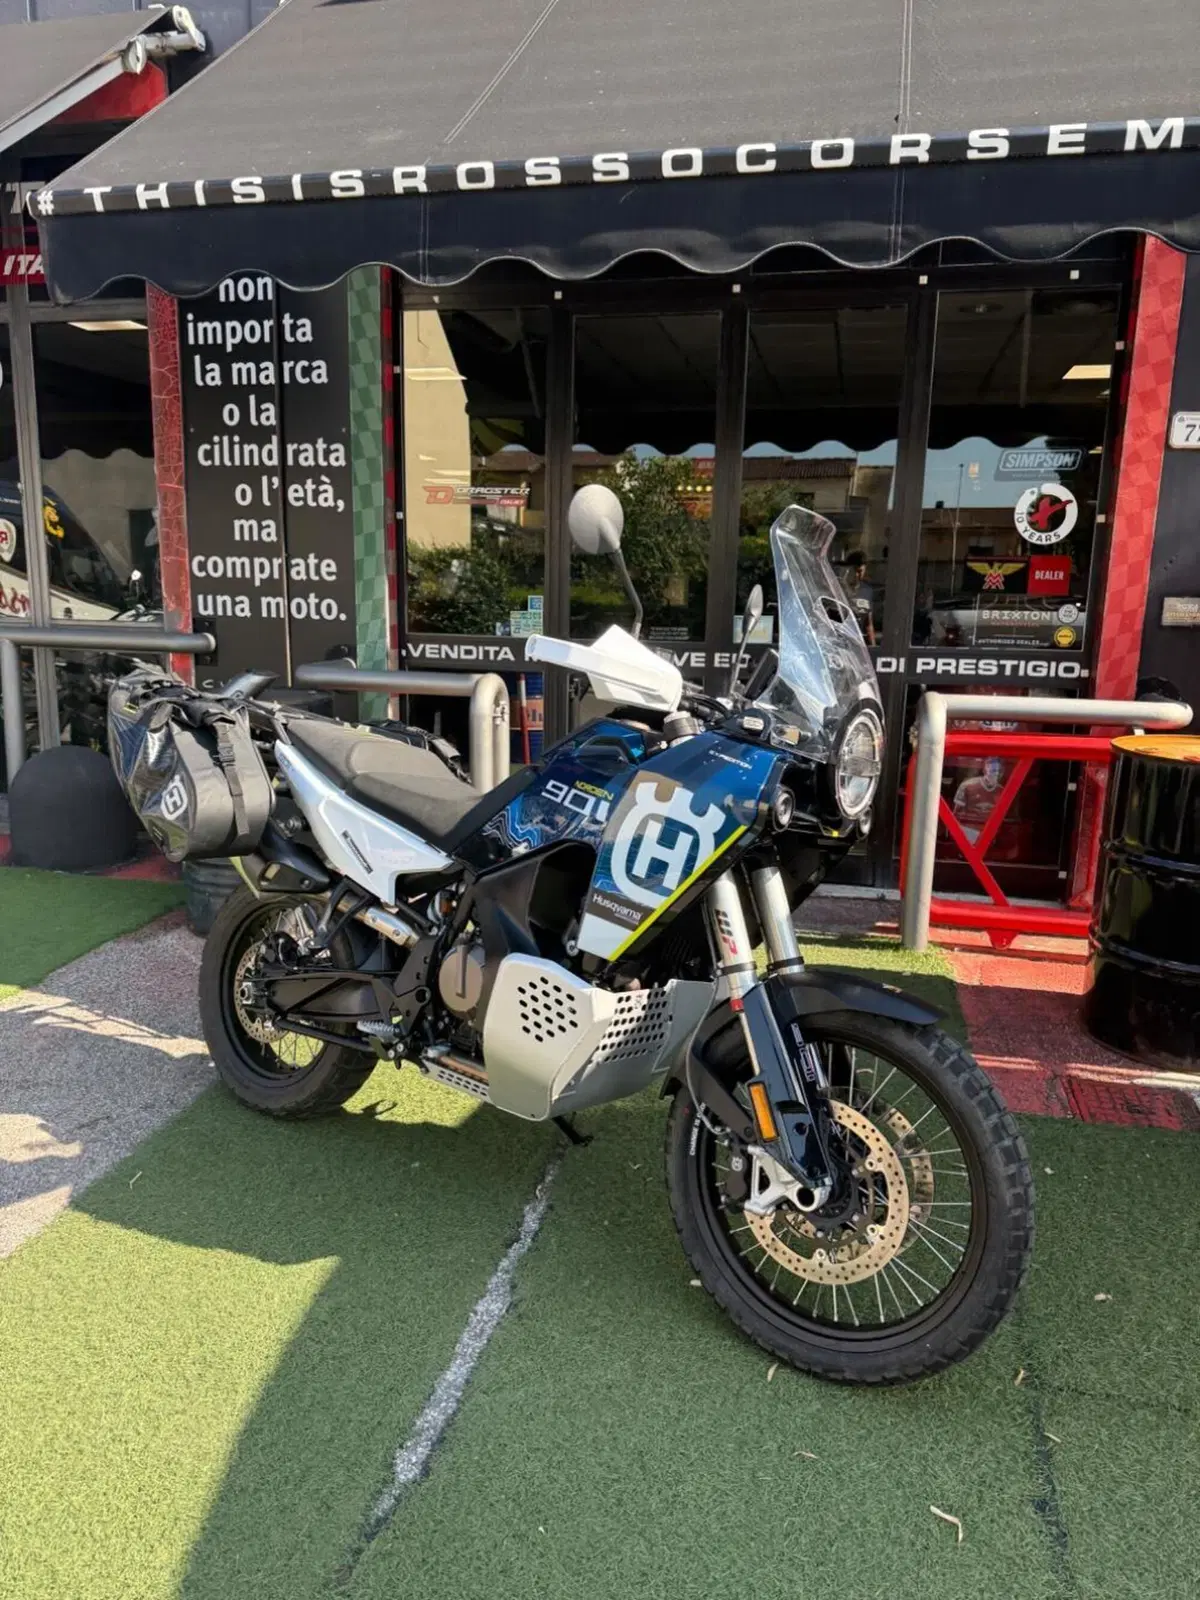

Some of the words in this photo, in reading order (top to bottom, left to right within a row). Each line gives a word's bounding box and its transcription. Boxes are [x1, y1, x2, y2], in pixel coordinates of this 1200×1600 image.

[219, 276, 275, 302] non
[187, 313, 314, 352] importa
[194, 355, 222, 387] la
[231, 358, 329, 386] marca
[222, 403, 240, 427] o
[249, 394, 277, 427] la
[1185, 424, 1200, 442] 7
[197, 435, 347, 467] cilindrata
[1005, 452, 1076, 468] SIMPSON
[235, 483, 252, 507] o
[456, 486, 531, 495] DRAGSTER
[233, 517, 278, 543] ma
[1022, 526, 1061, 543] YEARS
[192, 553, 337, 587] comprate
[1034, 570, 1064, 581] DEALER
[197, 594, 252, 619] una
[261, 593, 348, 621] moto.
[982, 609, 1051, 621] BRIXTON
[876, 656, 906, 674] DI
[541, 779, 612, 822] 901
[592, 893, 644, 921] Husqvarna
